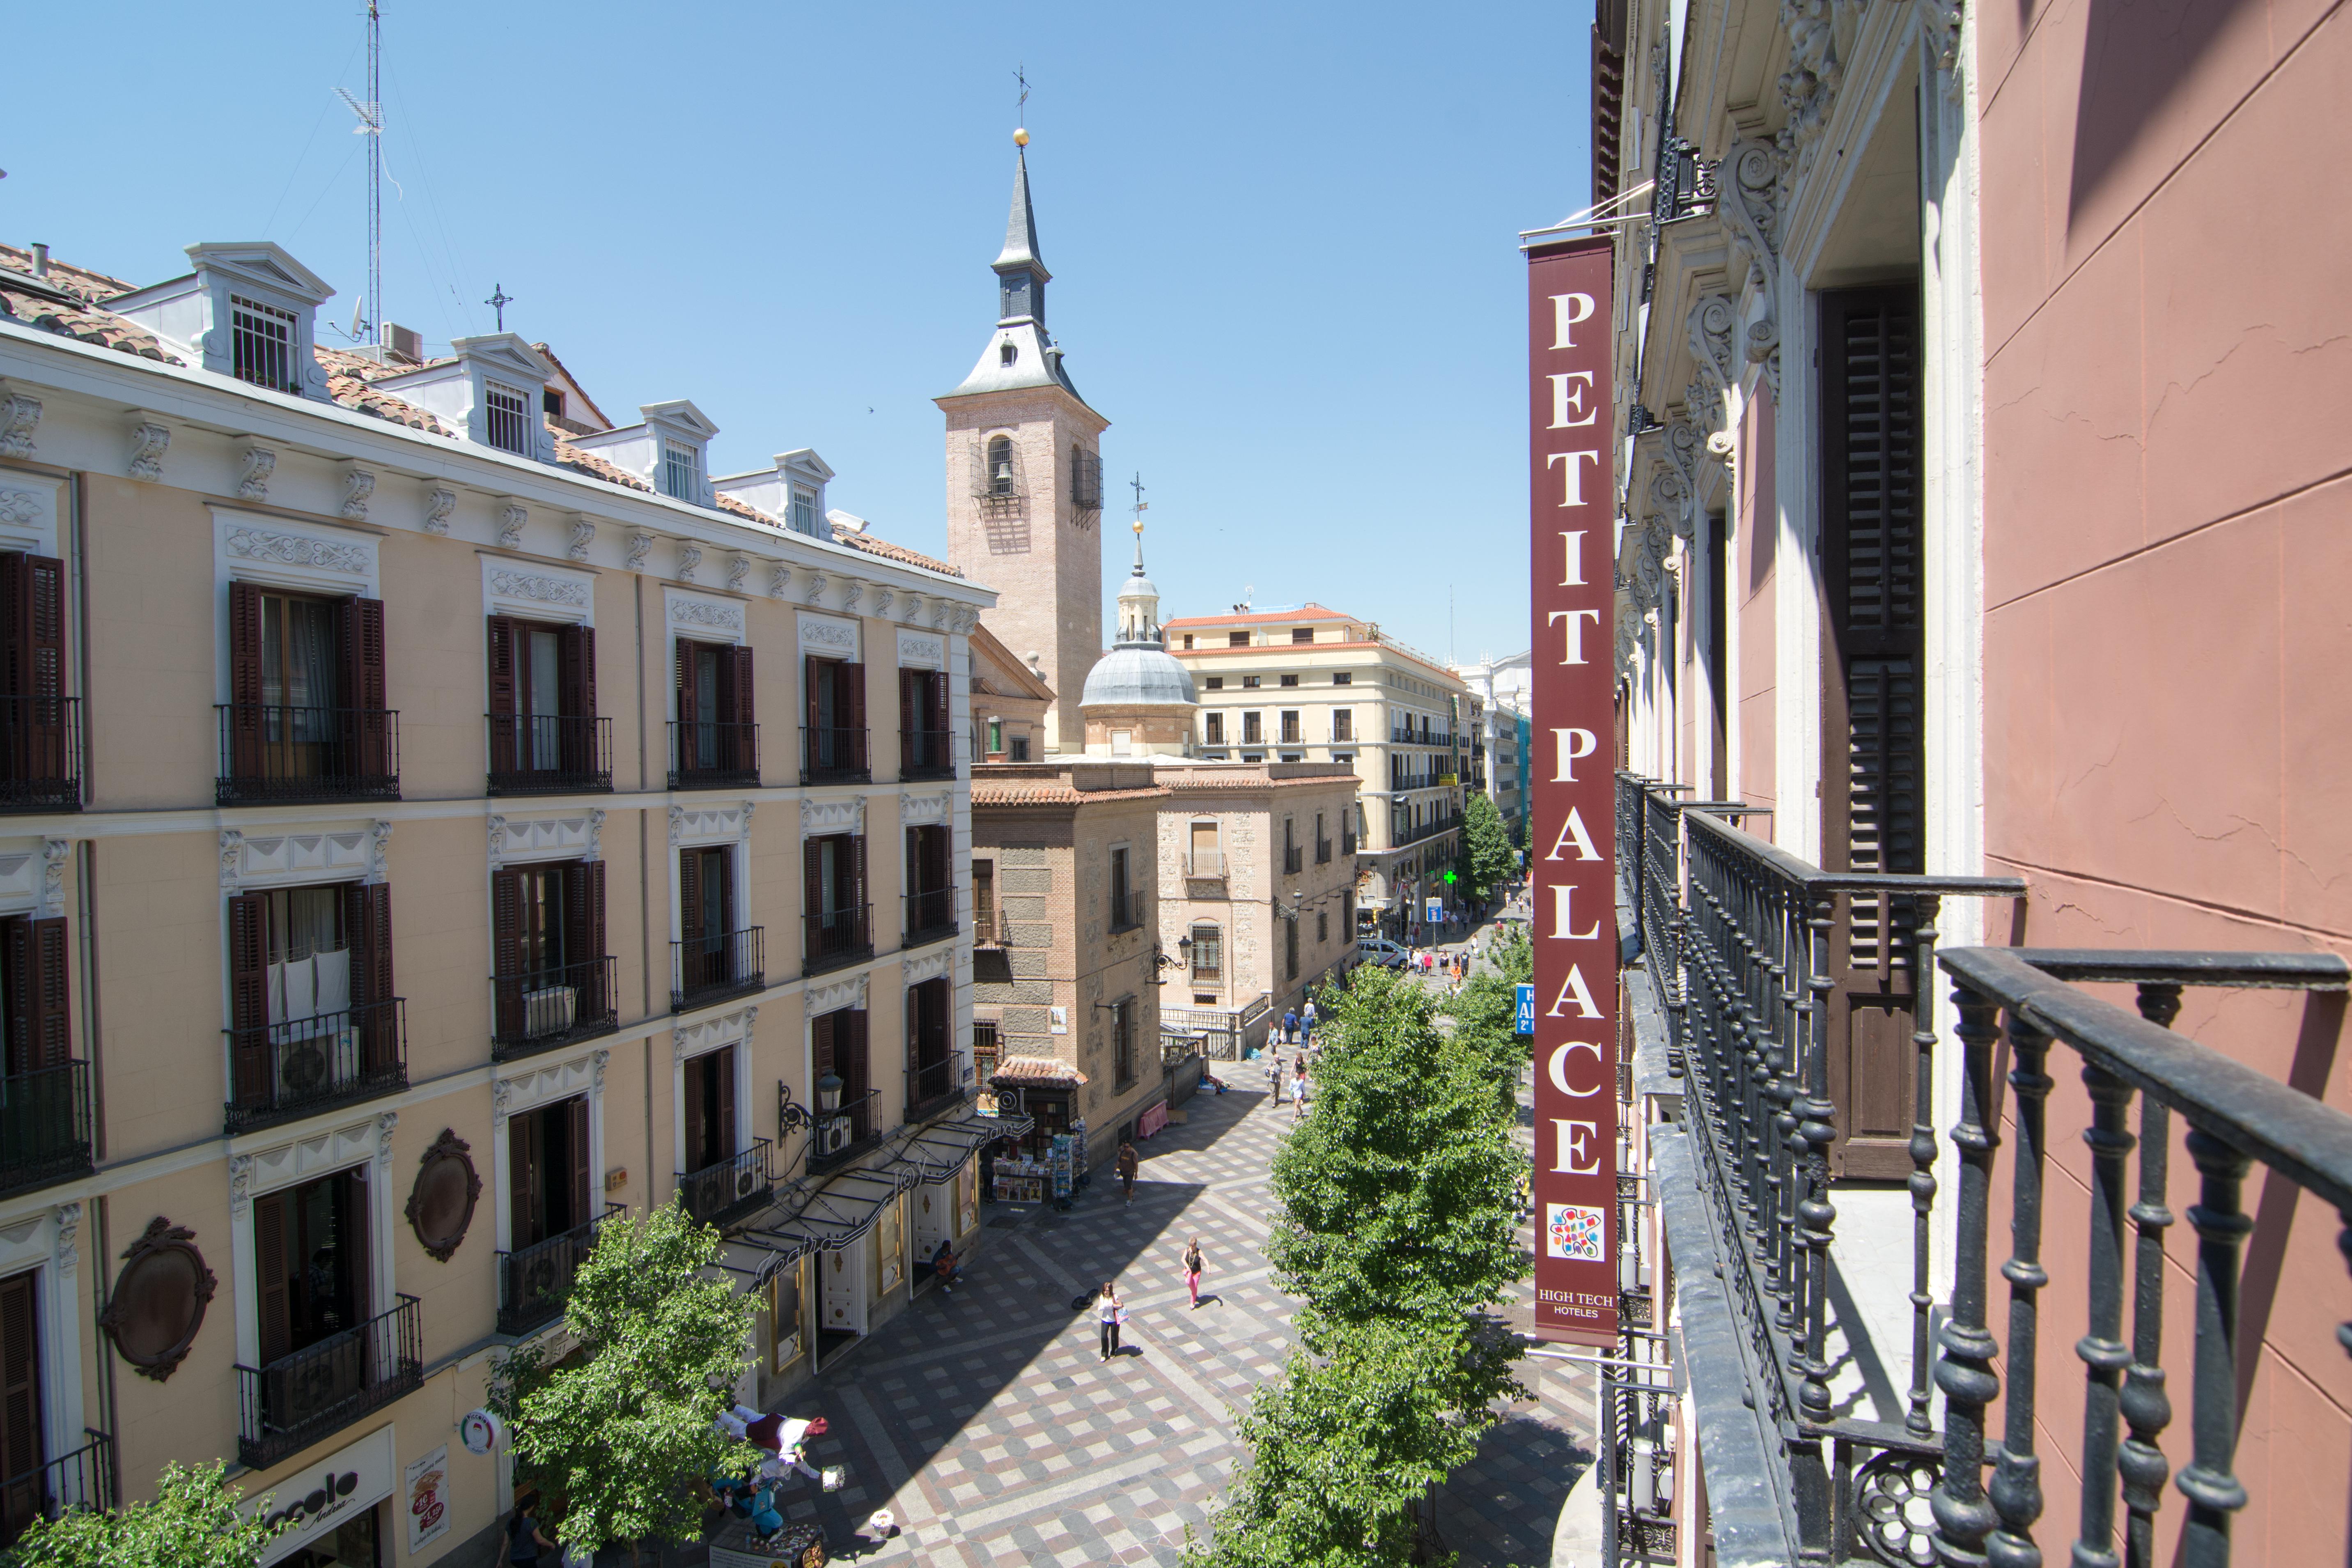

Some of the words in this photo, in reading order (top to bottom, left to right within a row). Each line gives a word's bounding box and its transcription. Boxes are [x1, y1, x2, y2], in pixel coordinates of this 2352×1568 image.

[1545, 293, 1600, 666] PETIT
[1544, 728, 1604, 1175] PALACE
[756, 1233, 833, 1287] Teatro
[969, 1125, 1014, 1157] Eslava
[1539, 1289, 1574, 1303] HIGH
[1576, 1293, 1613, 1307] TECH
[1554, 1306, 1598, 1318] HOTELES
[466, 1413, 486, 1424] Piccolo
[422, 1463, 434, 1474] nuevo
[255, 1472, 358, 1543] ccolo
[303, 1498, 355, 1531] Andrea
[423, 1504, 442, 1520] +1,25€
